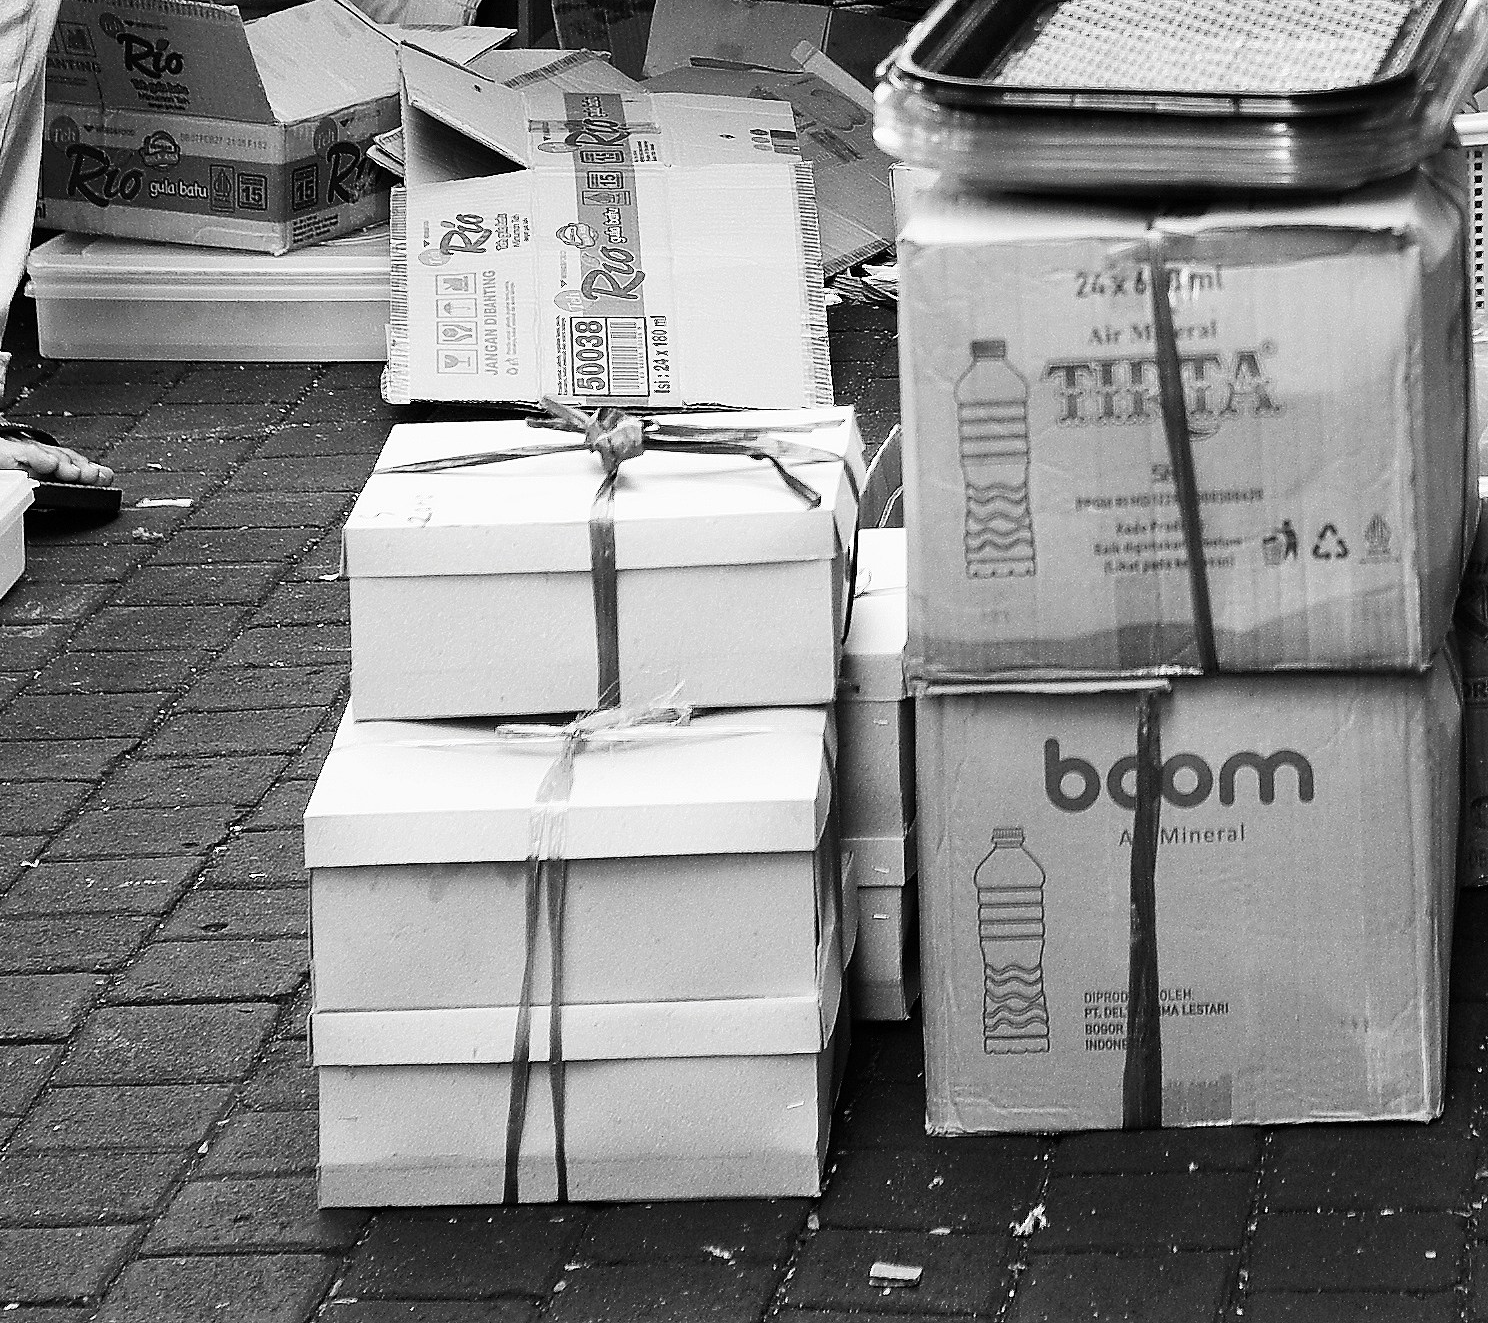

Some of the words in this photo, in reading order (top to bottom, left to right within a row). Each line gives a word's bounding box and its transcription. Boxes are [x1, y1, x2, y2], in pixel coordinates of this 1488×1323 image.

[115, 32, 184, 79] Rio
[64, 142, 146, 207] Rio
[148, 179, 177, 199] gula
[178, 179, 209, 200] batu
[240, 184, 264, 204] 15
[598, 174, 616, 187] 15
[439, 212, 493, 256] Rio
[580, 245, 646, 301] Rio
[481, 269, 498, 326] DIBANTING
[649, 315, 667, 327] ml
[651, 329, 668, 348] 180
[482, 328, 499, 376] JANGAN
[574, 319, 606, 392] 50038
[652, 358, 669, 372] 24
[1159, 822, 1246, 846] Mineral
[1084, 991, 1142, 1004] DIPROD
[1182, 1002, 1230, 1017] LESTARI
[1084, 1023, 1125, 1036] BOGOR
[1085, 1037, 1140, 1052] INDONE
